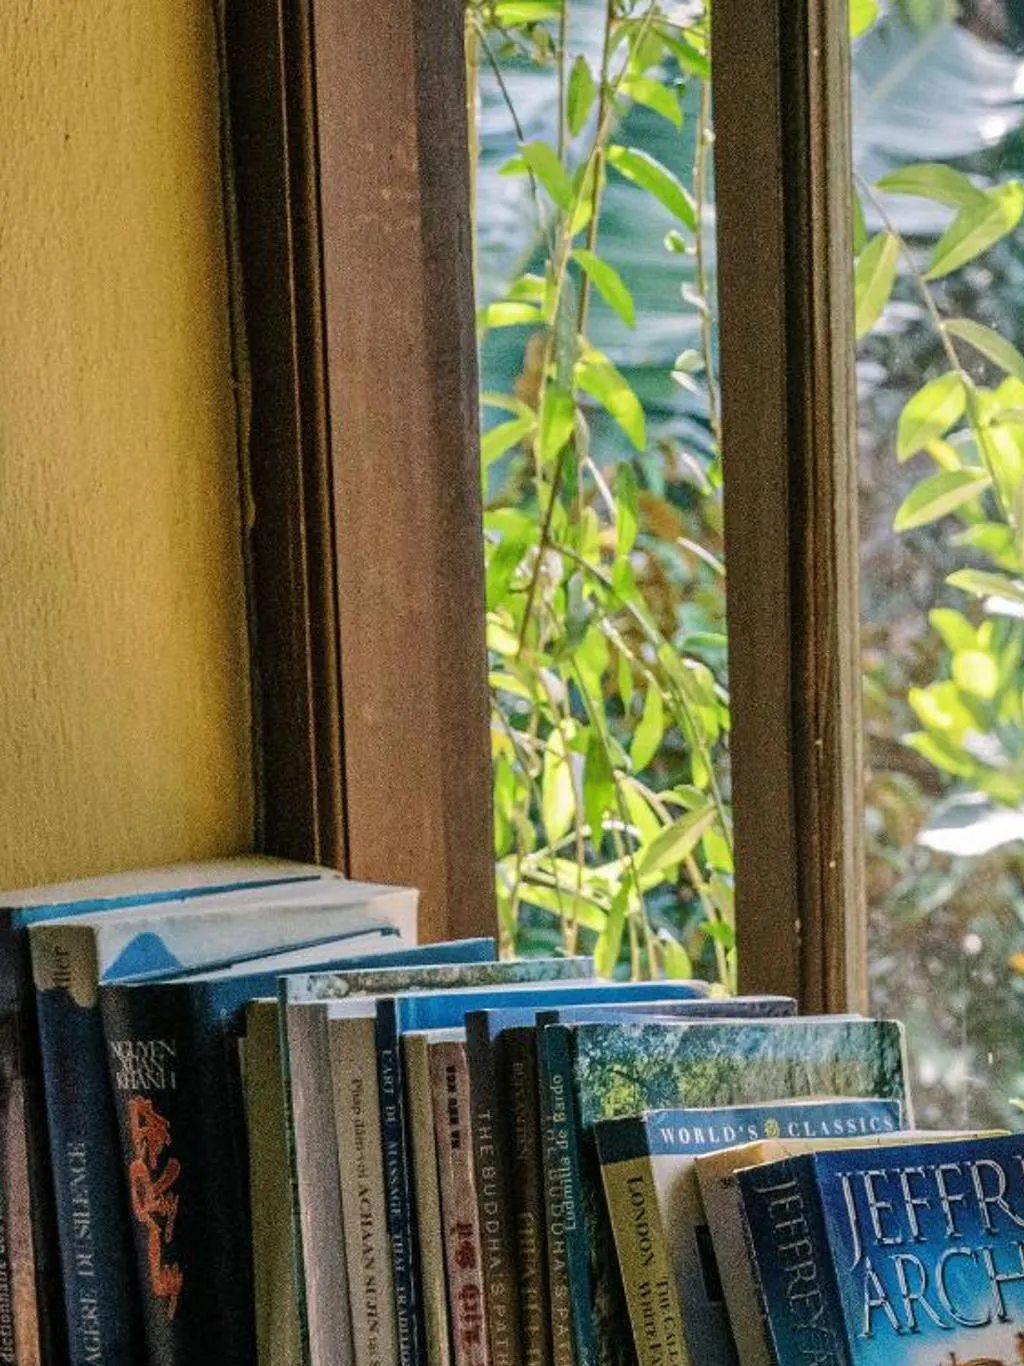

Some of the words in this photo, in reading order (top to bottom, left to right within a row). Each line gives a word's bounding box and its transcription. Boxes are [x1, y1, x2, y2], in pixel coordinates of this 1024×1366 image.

[380, 1049, 394, 1095] L'ART
[551, 1072, 569, 1123] Bardo
[384, 1104, 396, 1127] DU
[475, 1109, 495, 1158] THE
[556, 1127, 571, 1150] de
[660, 1126, 758, 1146] WORLD'S
[788, 1115, 894, 1138] CLASSICS
[67, 1141, 92, 1240] SILENCE
[385, 1140, 401, 1217] MASSAGE
[561, 1155, 579, 1231] Ludmilla
[358, 1183, 375, 1270] ACHAAN
[483, 1164, 506, 1296] BUDDHA'S
[626, 1175, 655, 1266] LONDON
[753, 1176, 831, 1343] JEFFREY
[363, 1275, 379, 1333] SUJIN
[637, 1281, 657, 1340] WHITE
[662, 1316, 680, 1363] CALL
